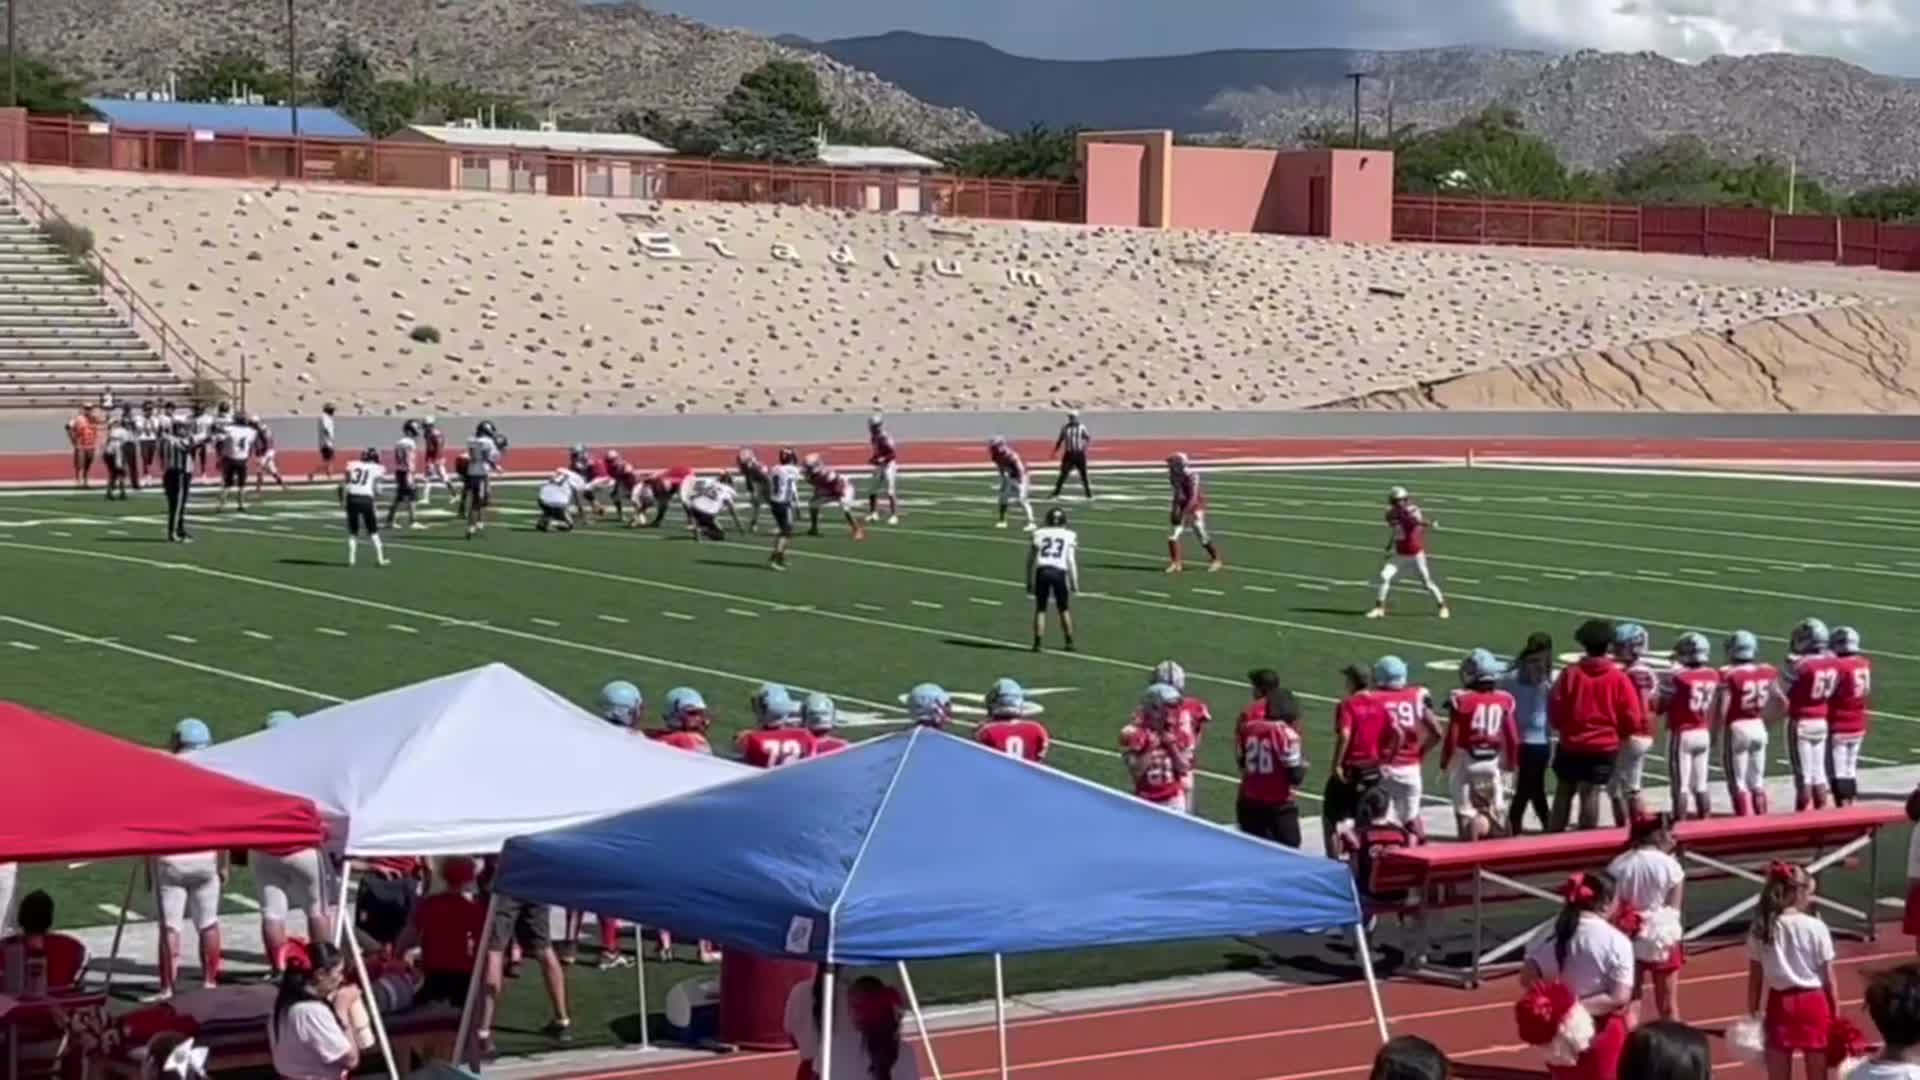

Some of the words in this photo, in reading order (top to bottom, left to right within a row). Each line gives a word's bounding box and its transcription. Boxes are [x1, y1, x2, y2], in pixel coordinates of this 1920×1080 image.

[350, 467, 370, 486] 31
[1040, 537, 1065, 558] 23
[1740, 679, 1769, 711] 25
[1471, 703, 1503, 736] 40
[1246, 736, 1273, 774] 26
